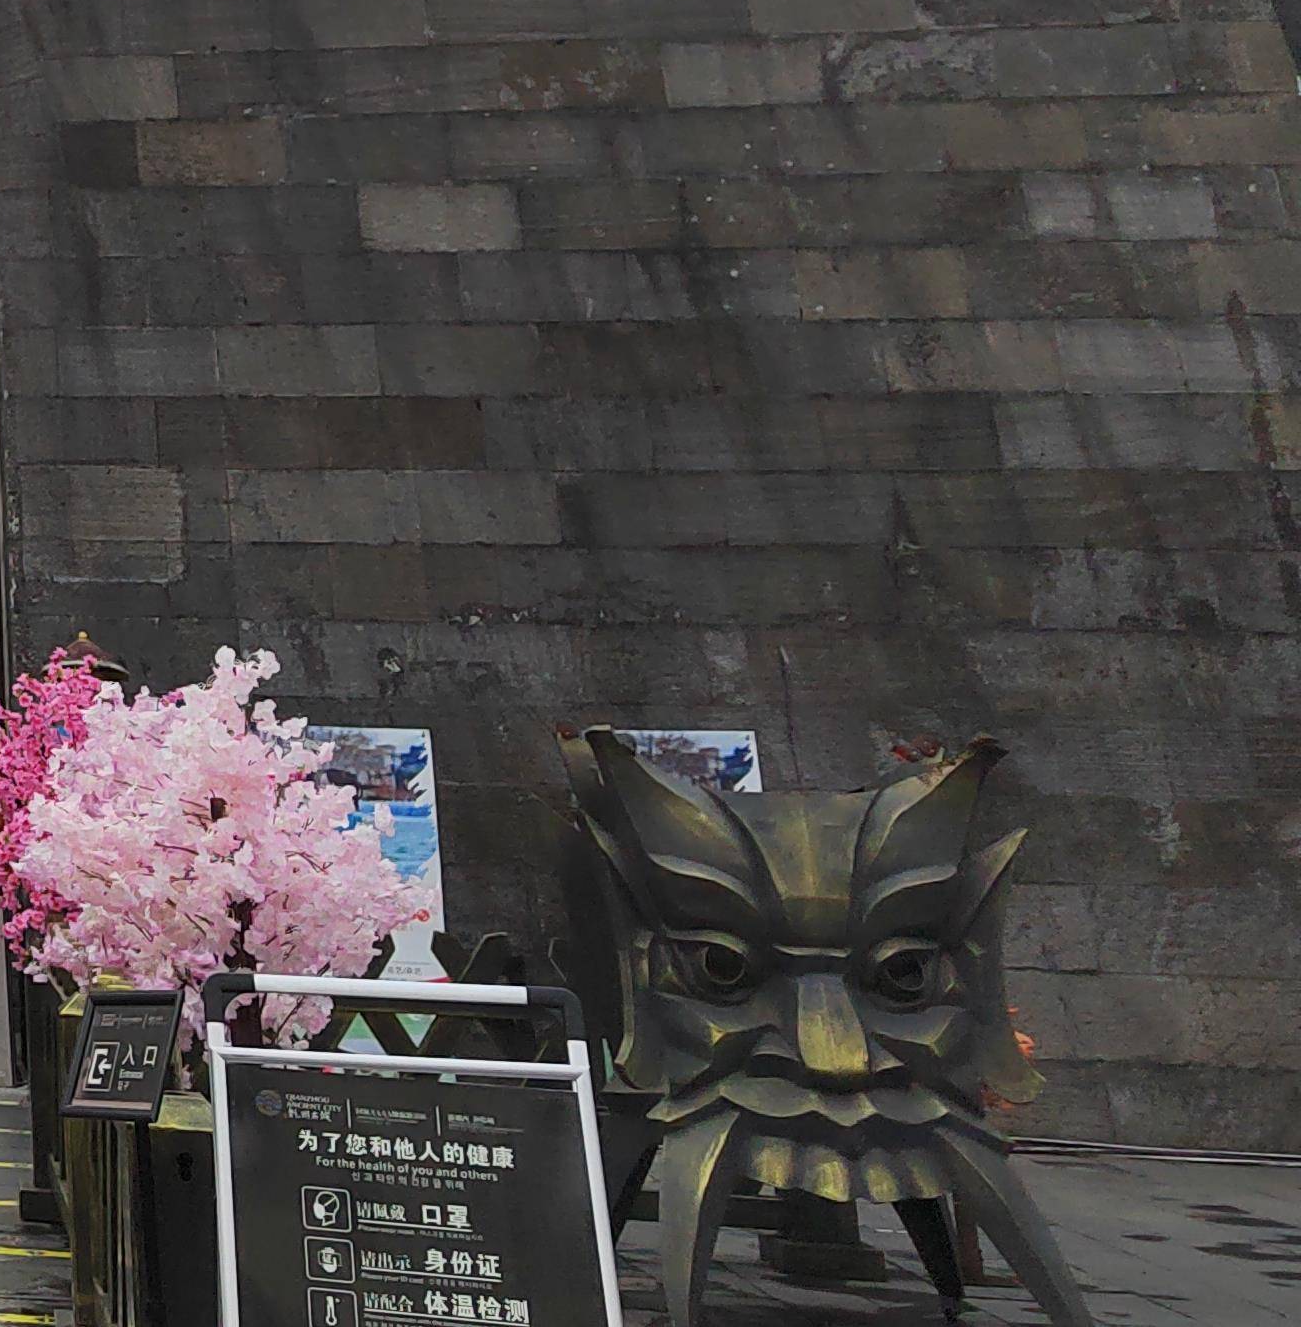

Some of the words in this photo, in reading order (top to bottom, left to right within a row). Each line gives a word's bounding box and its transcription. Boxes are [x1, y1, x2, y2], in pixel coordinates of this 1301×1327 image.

[121, 1043, 158, 1067] 入口
[298, 1128, 515, 1169] 为了您和他人的健康
[316, 1156, 333, 1168] For
[337, 1157, 355, 1169] the
[358, 1158, 395, 1172] health
[397, 1161, 410, 1174] of
[412, 1165, 433, 1180] you
[436, 1167, 458, 1179] and
[460, 1169, 499, 1182] others
[421, 1204, 472, 1228] 口罩
[424, 1248, 502, 1278] 身份证
[363, 1291, 414, 1312] 请配合
[424, 1290, 530, 1324] 体温检测
